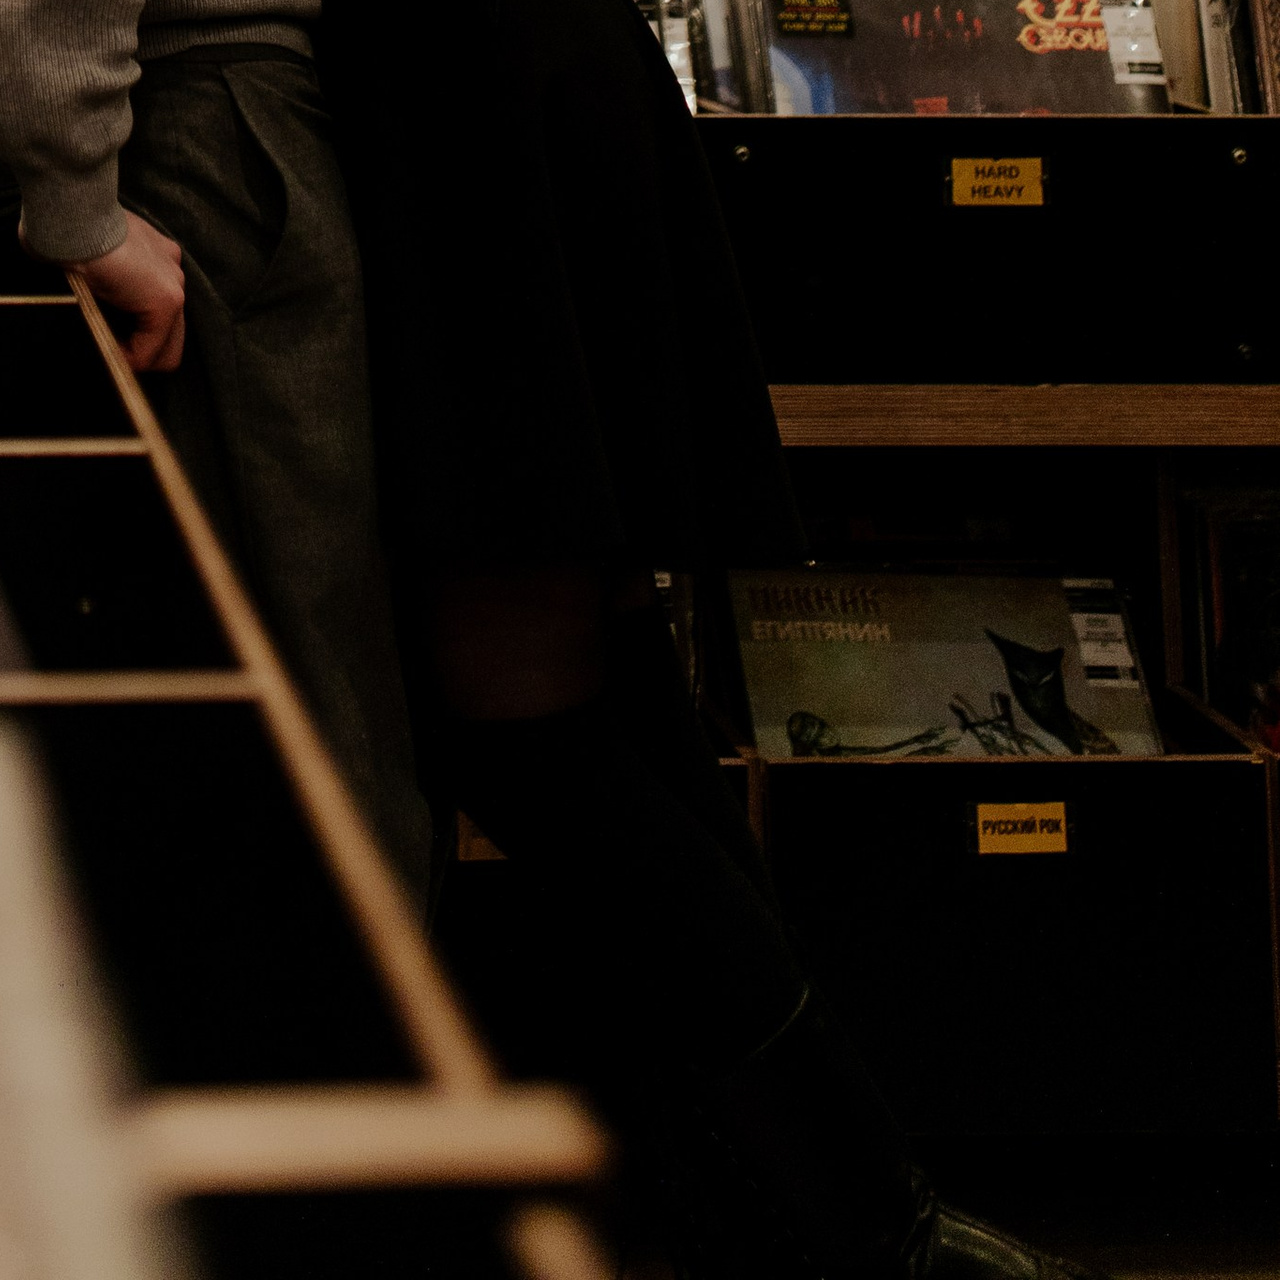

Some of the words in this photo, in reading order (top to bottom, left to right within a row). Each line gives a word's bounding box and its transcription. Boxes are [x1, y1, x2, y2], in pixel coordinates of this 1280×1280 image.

[974, 166, 1021, 179] HARD
[970, 184, 1026, 198] HEAVY
[750, 619, 892, 642] ЕГИПТЯНИН
[982, 816, 1037, 836] РУССКИЙ
[1039, 818, 1062, 835] РОК
